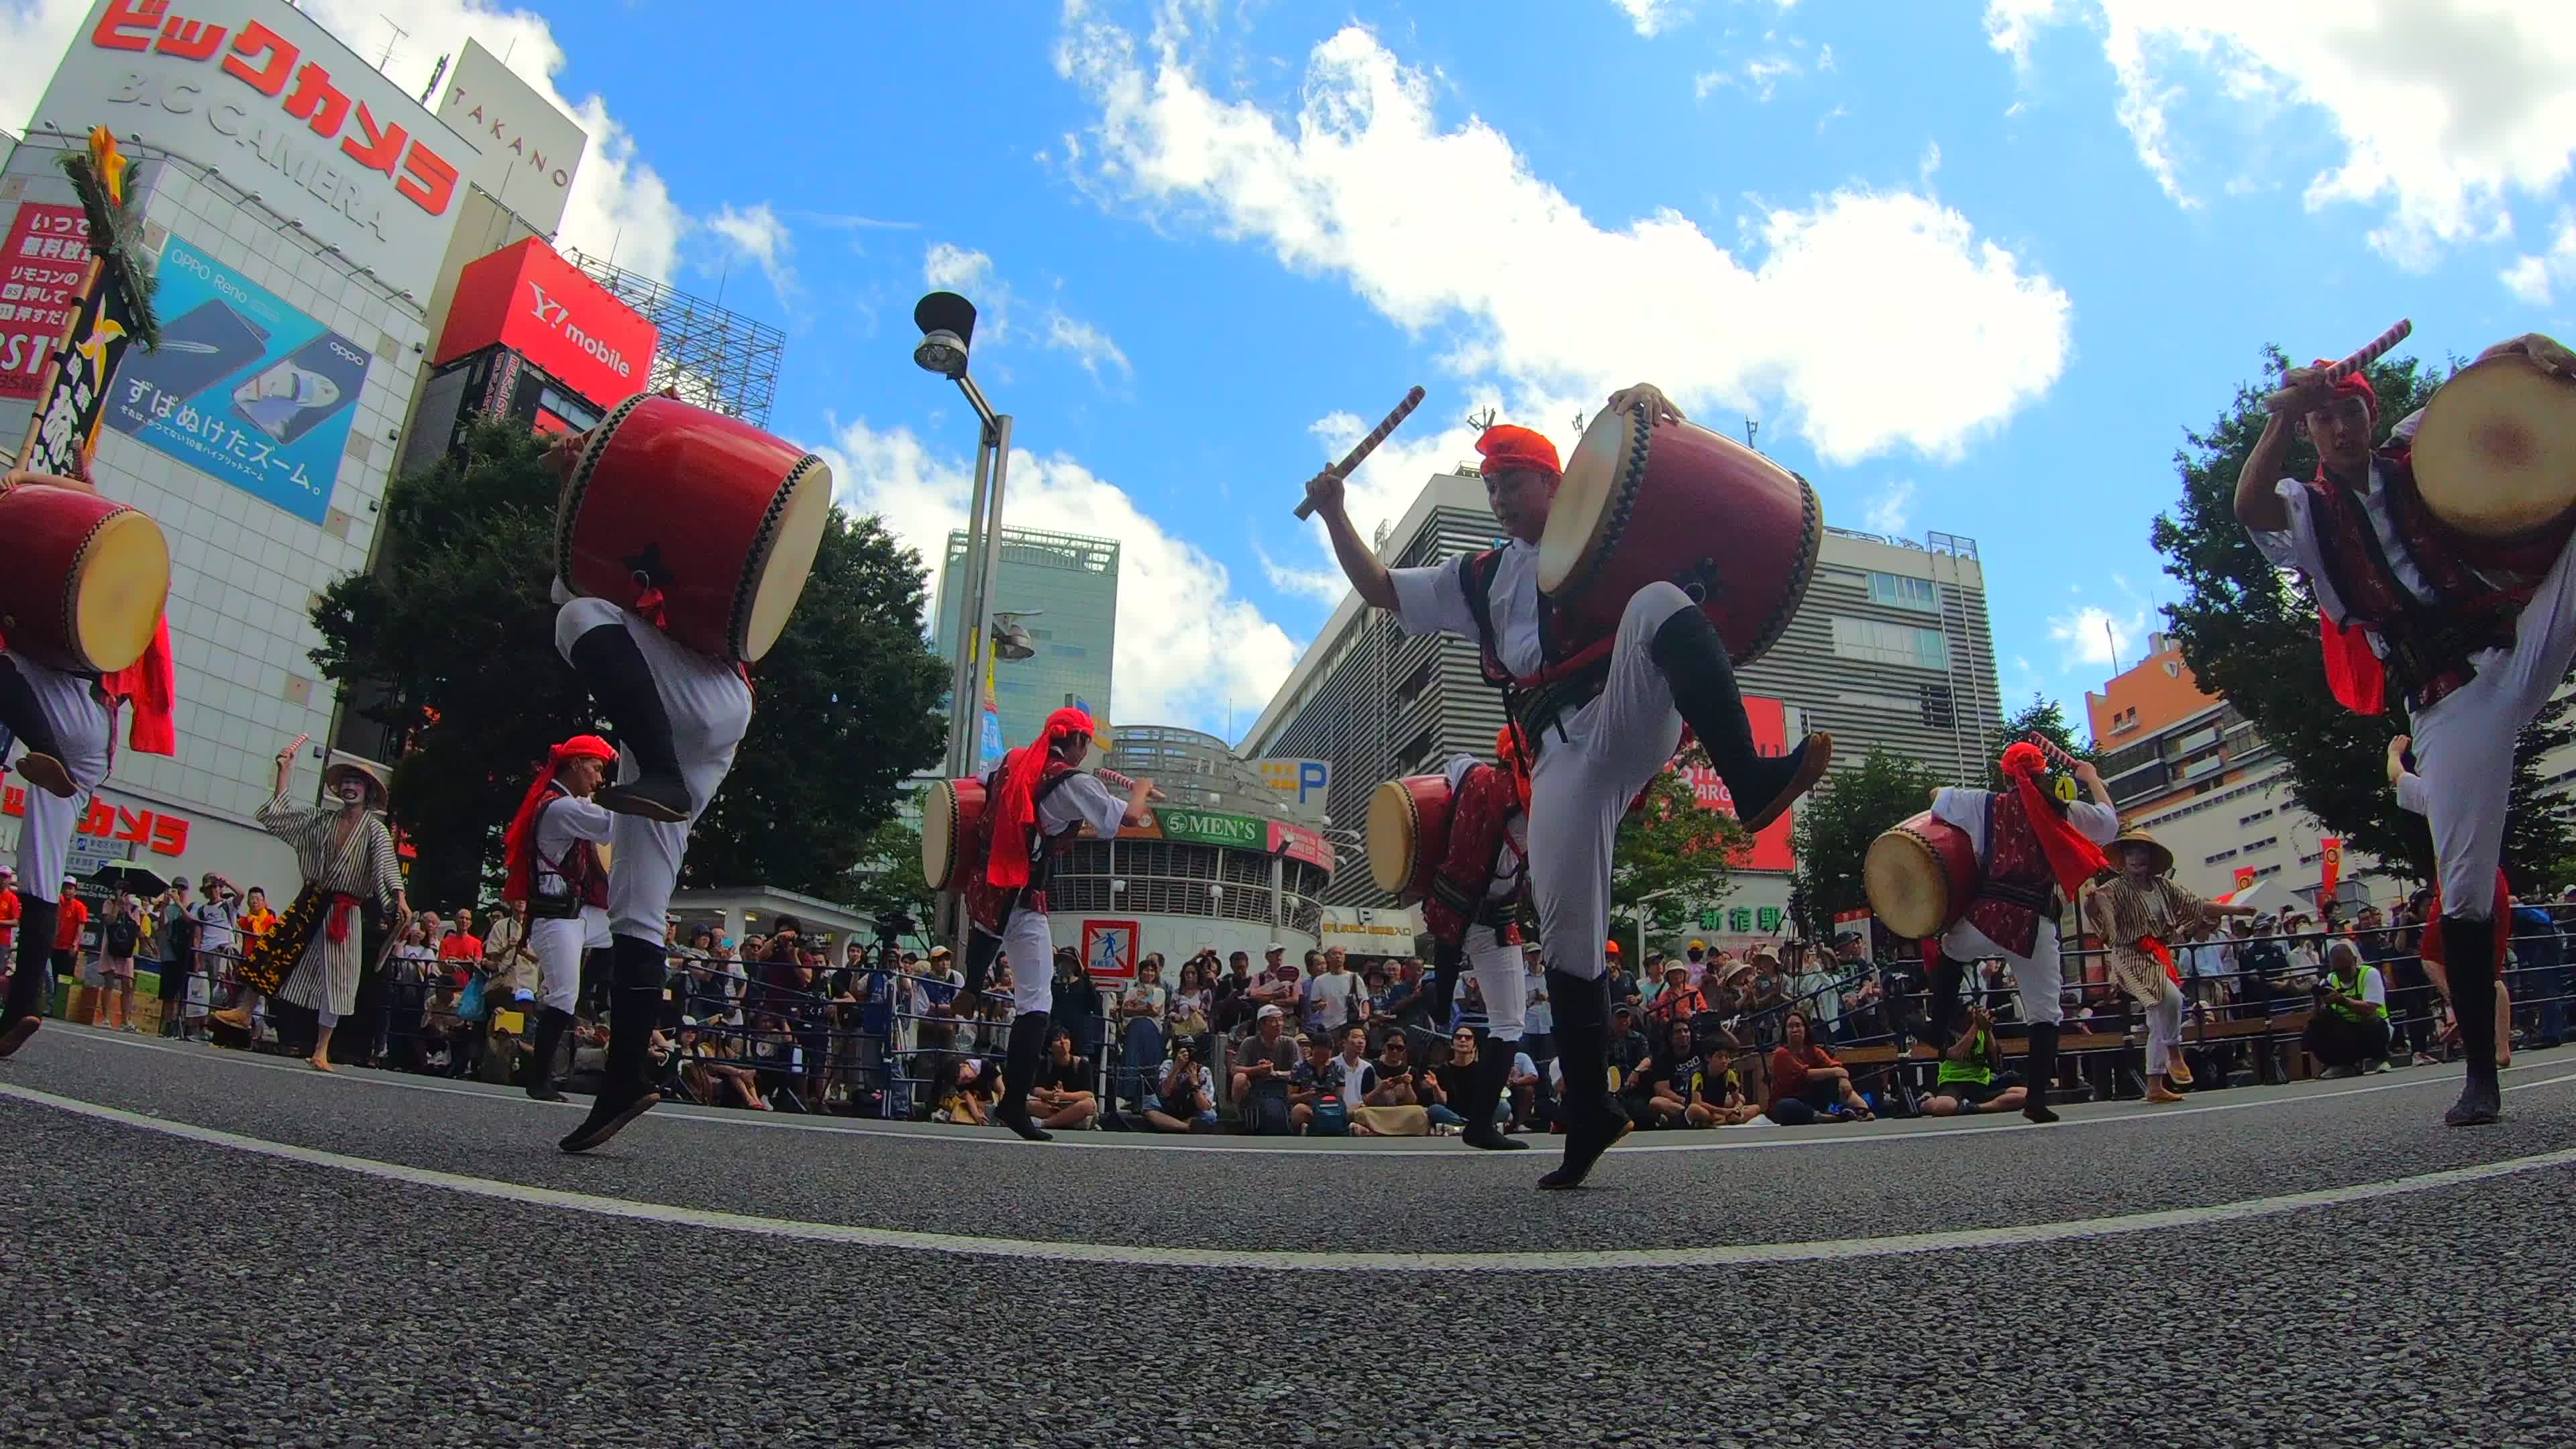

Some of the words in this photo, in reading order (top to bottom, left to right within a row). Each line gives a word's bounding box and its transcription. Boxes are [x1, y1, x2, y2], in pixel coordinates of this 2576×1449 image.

[92, 0, 460, 216] ビックカメラ
[107, 70, 203, 115] BIC
[207, 99, 387, 244] CAMERA
[452, 87, 569, 189] TAKANO
[10, 266, 78, 286] リモコンの
[171, 248, 212, 281] OPPO
[213, 273, 248, 305] Reno
[329, 340, 364, 368] oppo
[528, 279, 570, 329] Y!
[564, 322, 632, 380] mobile
[127, 377, 321, 496] ずばぬけたズーム。
[1299, 761, 1327, 804] P
[1188, 815, 1256, 841] MEN'S
[1701, 906, 1782, 931] 新宿駅
